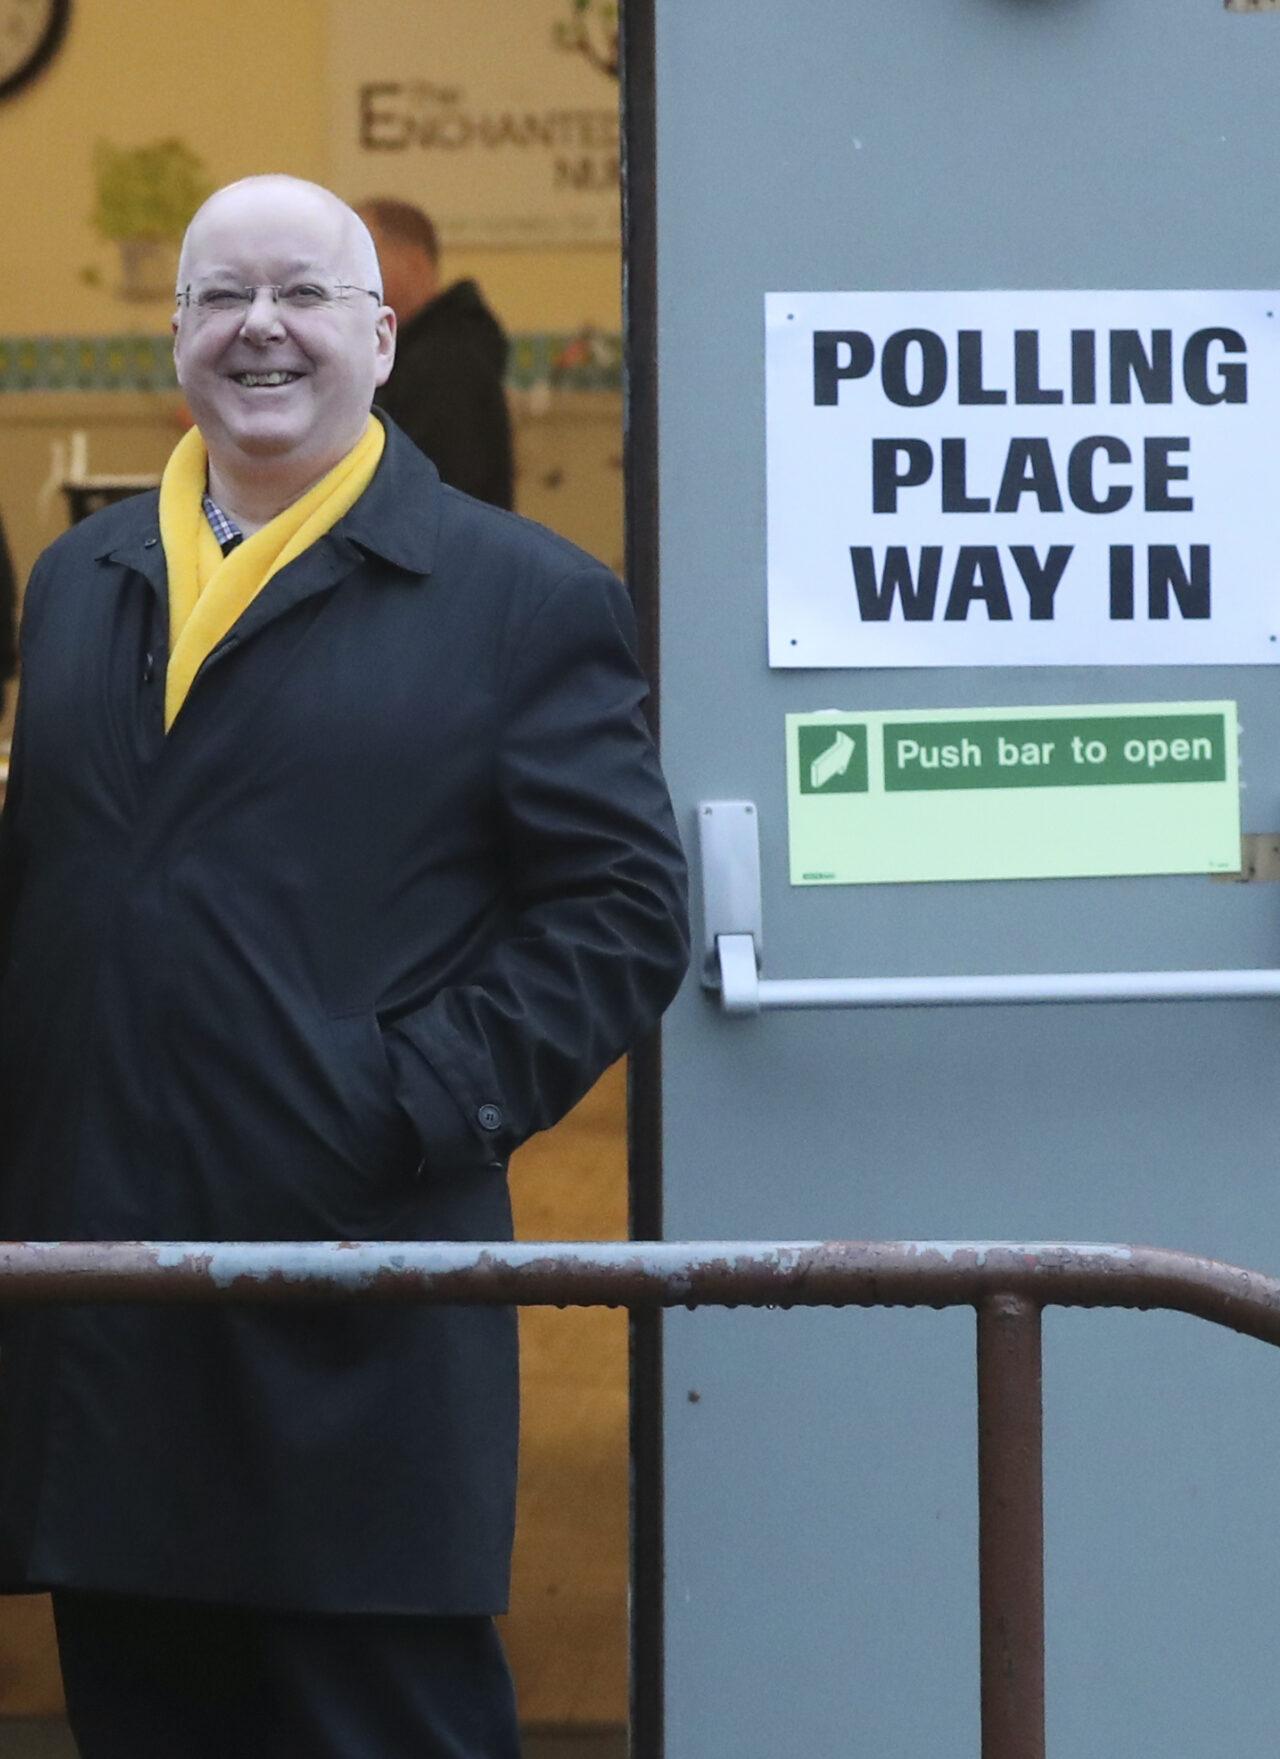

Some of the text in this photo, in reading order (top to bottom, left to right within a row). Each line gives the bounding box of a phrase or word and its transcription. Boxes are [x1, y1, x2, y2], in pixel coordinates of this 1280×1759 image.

[813, 327, 1248, 407] POLLING
[872, 435, 1194, 515] PLACE
[849, 544, 1212, 622] WAY IN
[897, 733, 1213, 768] Push bar to open
